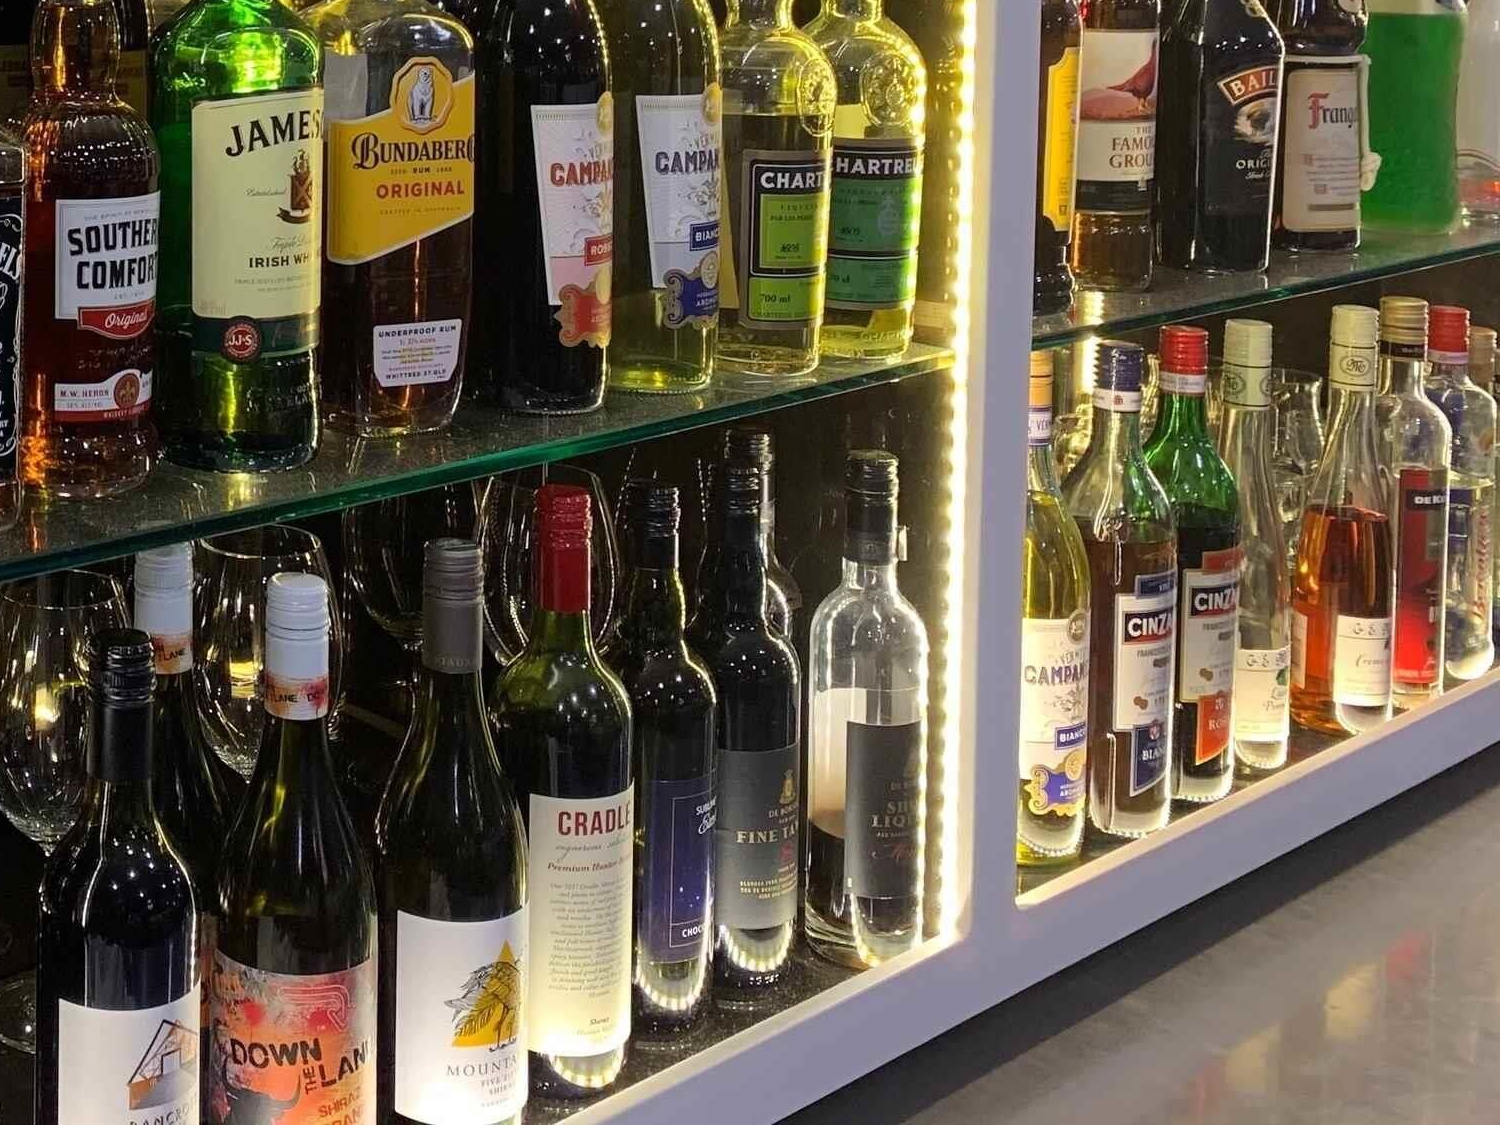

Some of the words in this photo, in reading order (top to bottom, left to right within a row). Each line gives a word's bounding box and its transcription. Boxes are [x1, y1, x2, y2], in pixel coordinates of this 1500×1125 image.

[760, 170, 825, 189] CHART
[375, 181, 466, 200] ORIGINAL
[68, 217, 158, 257] SOUTHER
[249, 256, 289, 269] IRISH
[103, 309, 148, 328] Original
[378, 326, 436, 338] UNDERPROOF
[439, 324, 458, 334] RUM
[82, 388, 109, 398] HERON
[1193, 586, 1240, 613] CINZA
[1127, 614, 1174, 639] CINZA
[736, 829, 778, 844] FINE
[230, 1037, 323, 1069] DOWN
[446, 1054, 517, 1077] MOUNTA
[303, 1065, 318, 1095] THE
